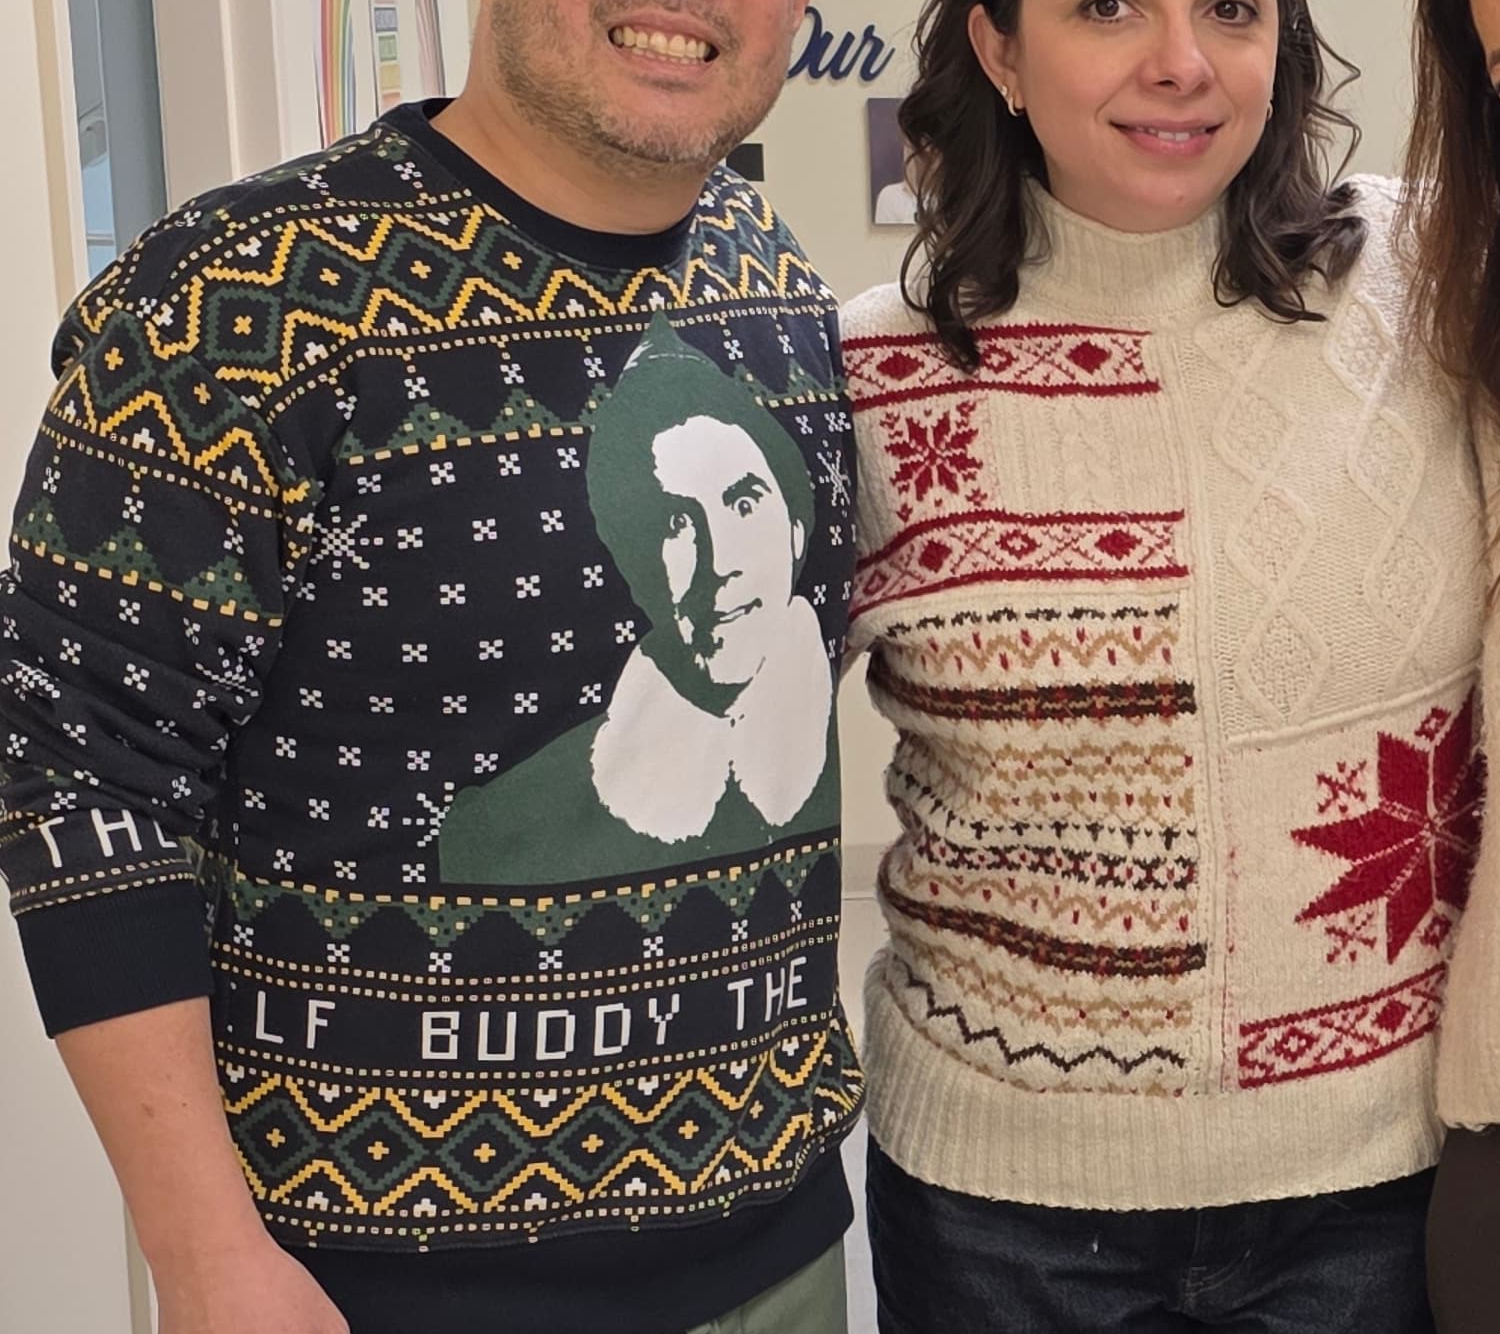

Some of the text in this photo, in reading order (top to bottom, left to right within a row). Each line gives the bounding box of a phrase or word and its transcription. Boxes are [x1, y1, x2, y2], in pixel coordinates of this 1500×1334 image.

[228, 956, 808, 1061] LF BUDDY THE
